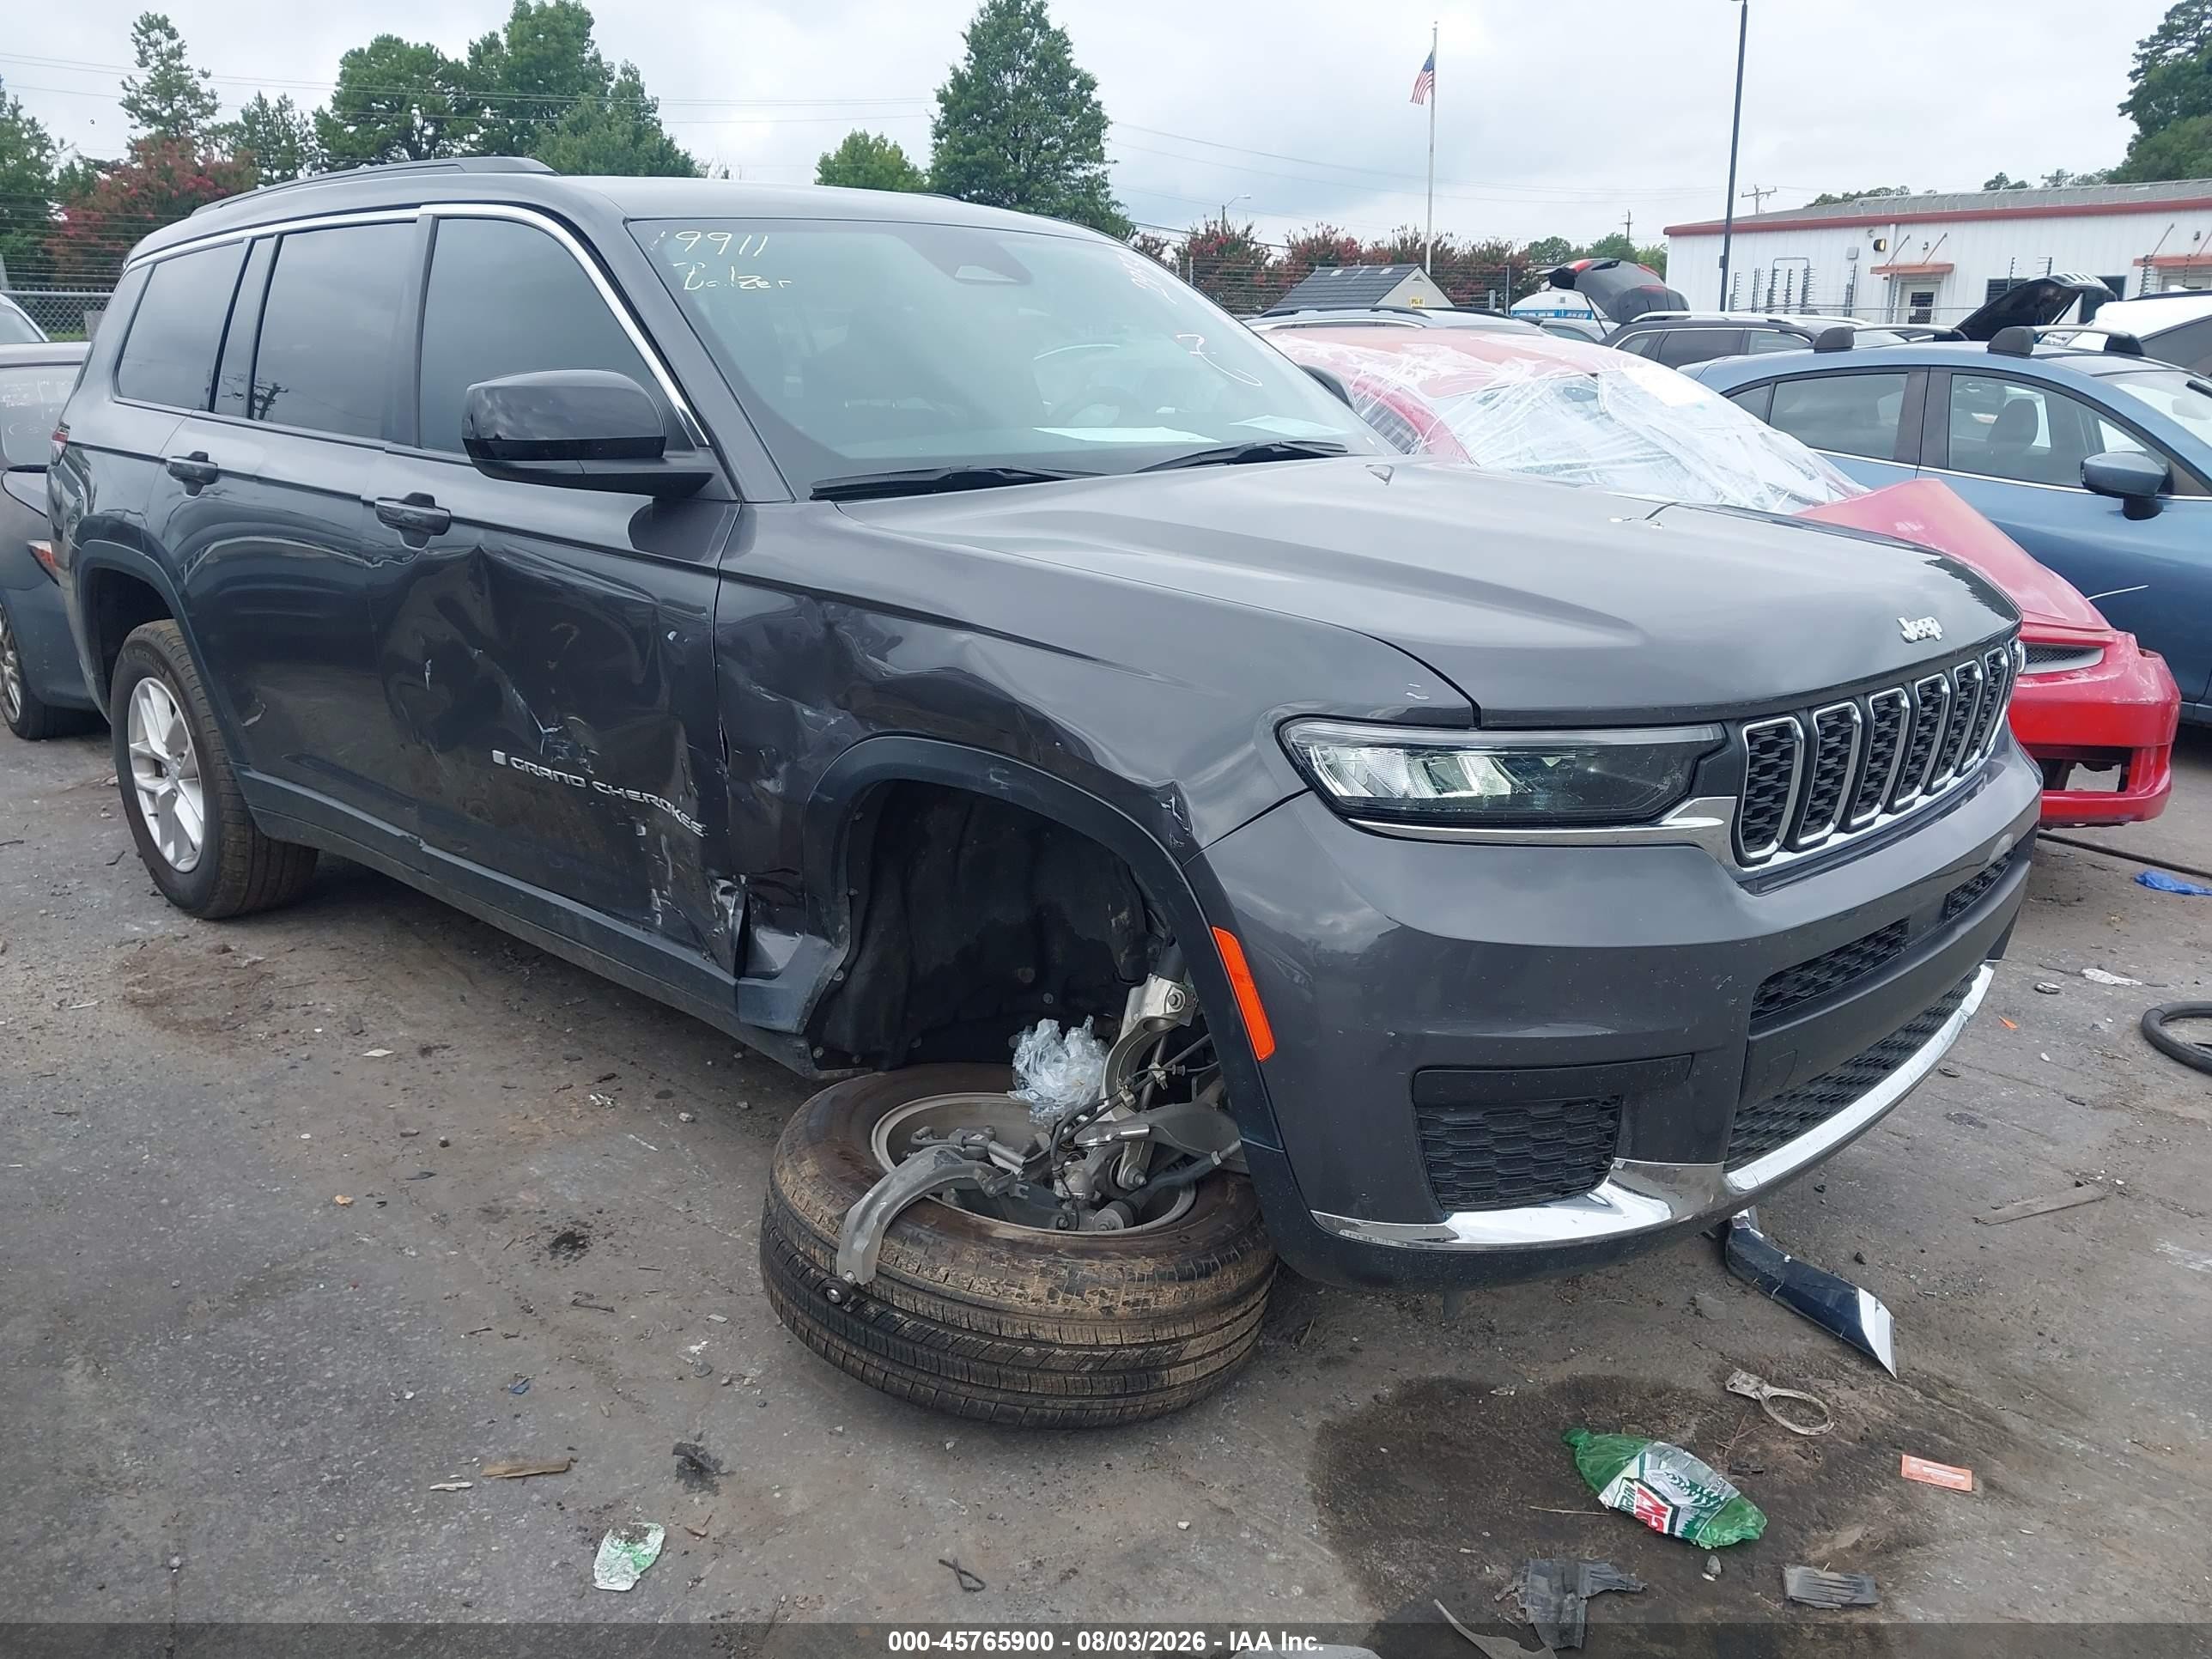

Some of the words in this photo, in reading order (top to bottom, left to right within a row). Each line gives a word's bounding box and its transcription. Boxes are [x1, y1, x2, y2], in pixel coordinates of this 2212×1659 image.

[1897, 616, 1942, 642] Jeep
[509, 756, 586, 787] GRAND
[592, 781, 708, 837] CHEROKEE
